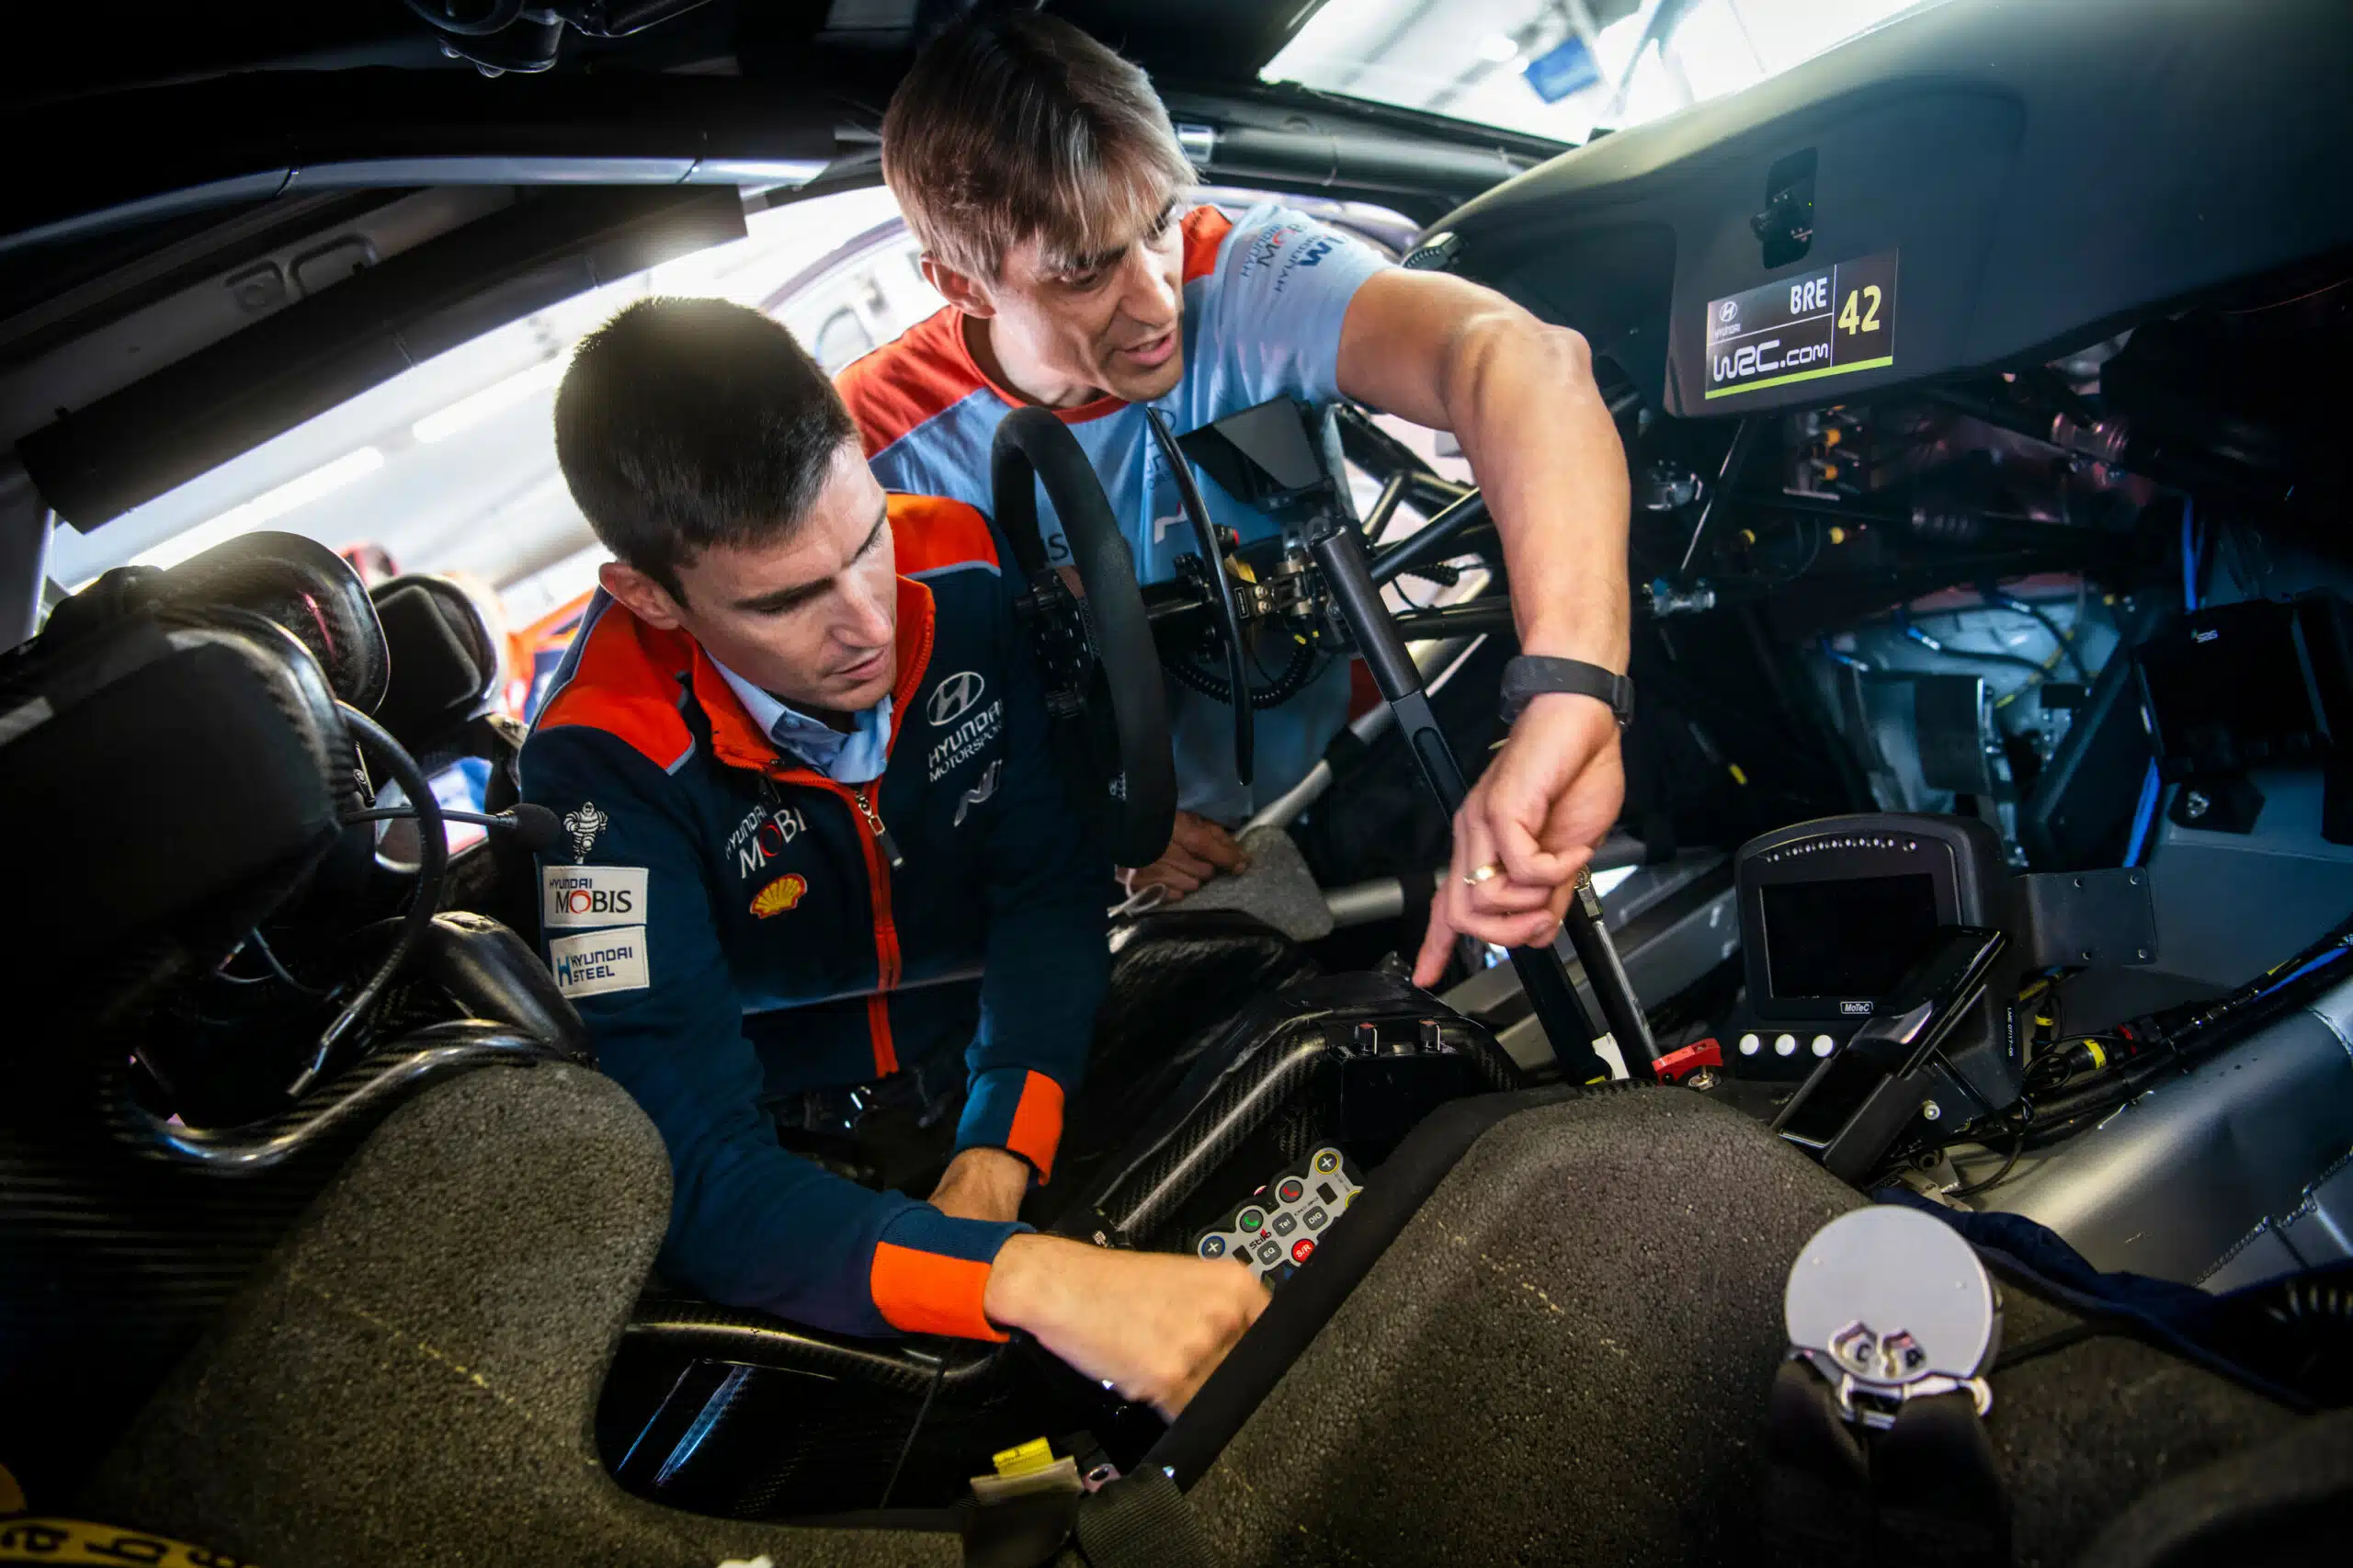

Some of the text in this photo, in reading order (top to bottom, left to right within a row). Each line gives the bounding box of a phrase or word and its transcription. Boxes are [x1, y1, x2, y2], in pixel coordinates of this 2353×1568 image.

[1790, 277, 1827, 314] BRE
[1838, 284, 1882, 335] 42
[549, 878, 593, 890] HYUNDAI
[555, 889, 632, 915] MOBIS
[570, 946, 633, 968] HYUNDAI
[573, 965, 616, 983] STEEL
[1278, 1219, 1290, 1229] Tel
[1308, 1211, 1323, 1224] DIG
[1296, 1244, 1313, 1258] S/R
